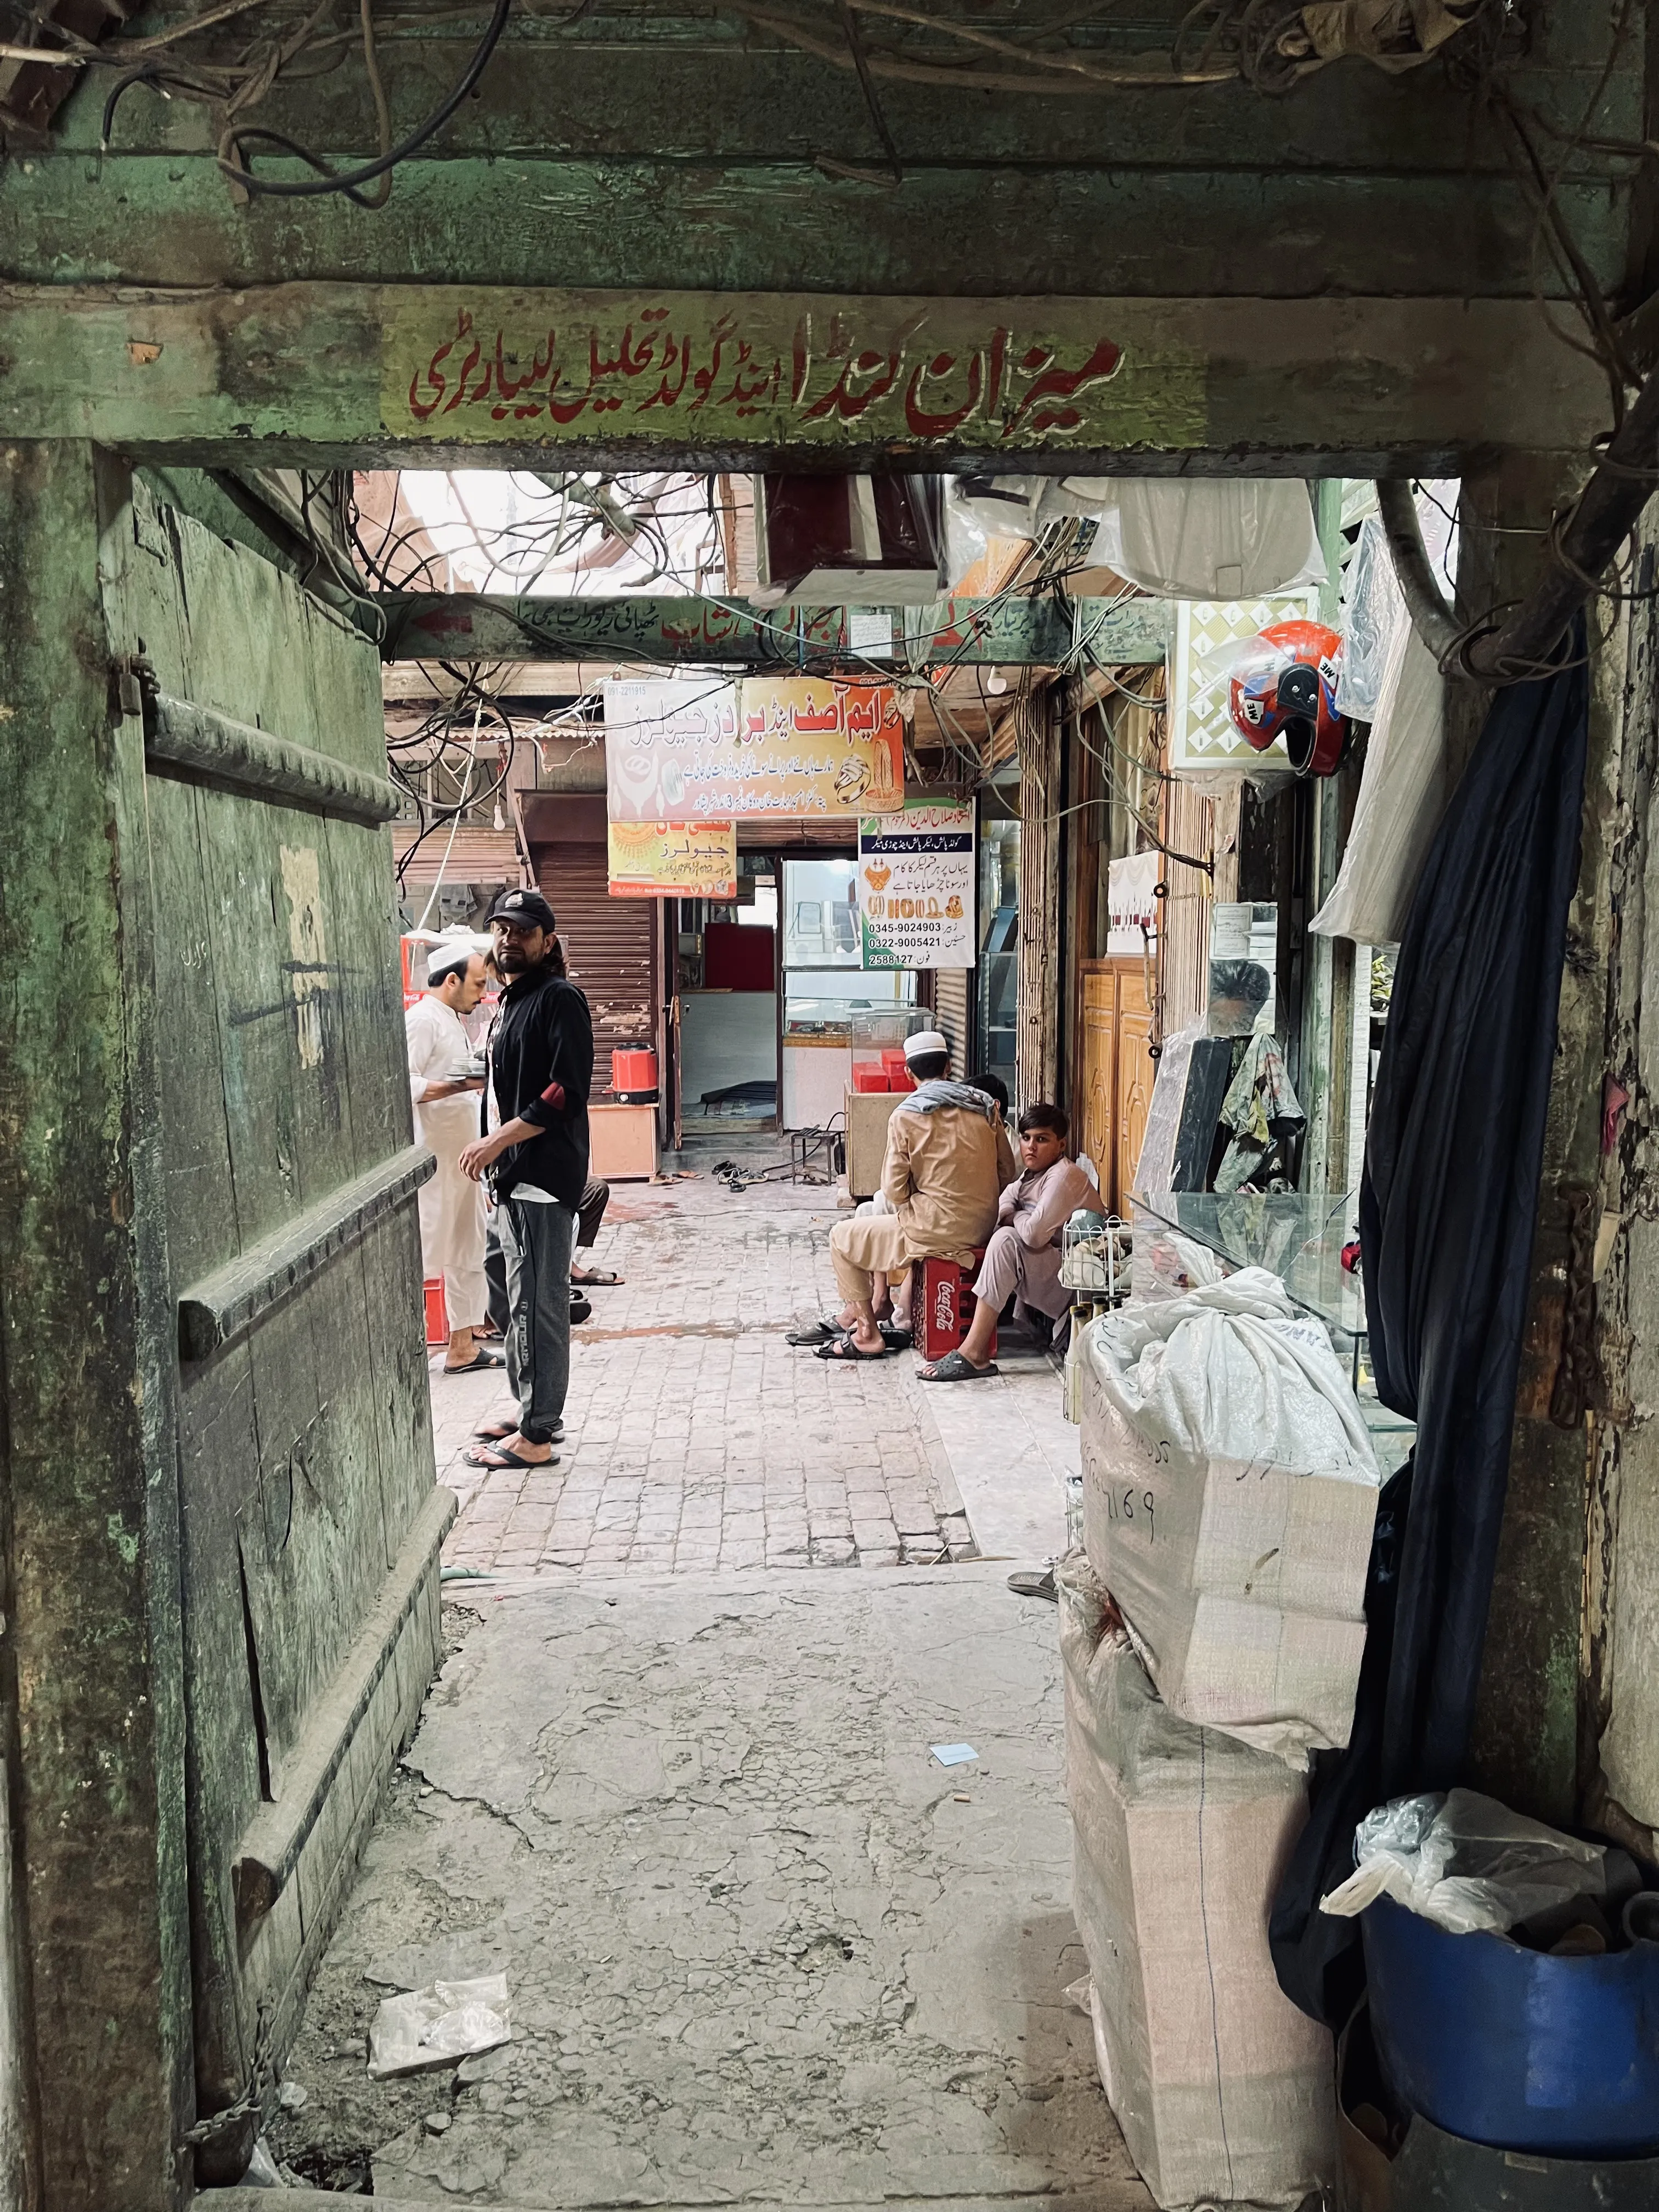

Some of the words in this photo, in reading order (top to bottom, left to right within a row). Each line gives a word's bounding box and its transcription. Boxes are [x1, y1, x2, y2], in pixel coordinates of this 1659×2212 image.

[635, 308, 739, 414] گولڈ
[905, 326, 1125, 438] میزان
[1320, 662, 1335, 679] ME
[769, 696, 792, 737] اینڈ
[795, 685, 849, 733] آصف
[1246, 703, 1259, 720] ME
[631, 699, 708, 745] جیولرز
[848, 691, 880, 745] ایم
[684, 765, 694, 785] ہے
[727, 794, 733, 809] 3
[910, 808, 932, 830] الدین
[931, 808, 953, 827] صلاح
[659, 839, 729, 859] جیولرز
[908, 837, 922, 851] پالش
[893, 861, 909, 878] کام
[941, 865, 949, 877] پر
[949, 862, 968, 876] یہاں
[893, 882, 906, 895] ہے
[957, 879, 969, 889] اور
[869, 922, 941, 933] 0345-9024903
[869, 937, 941, 948] 0322-9005421
[870, 955, 913, 965] 2588127
